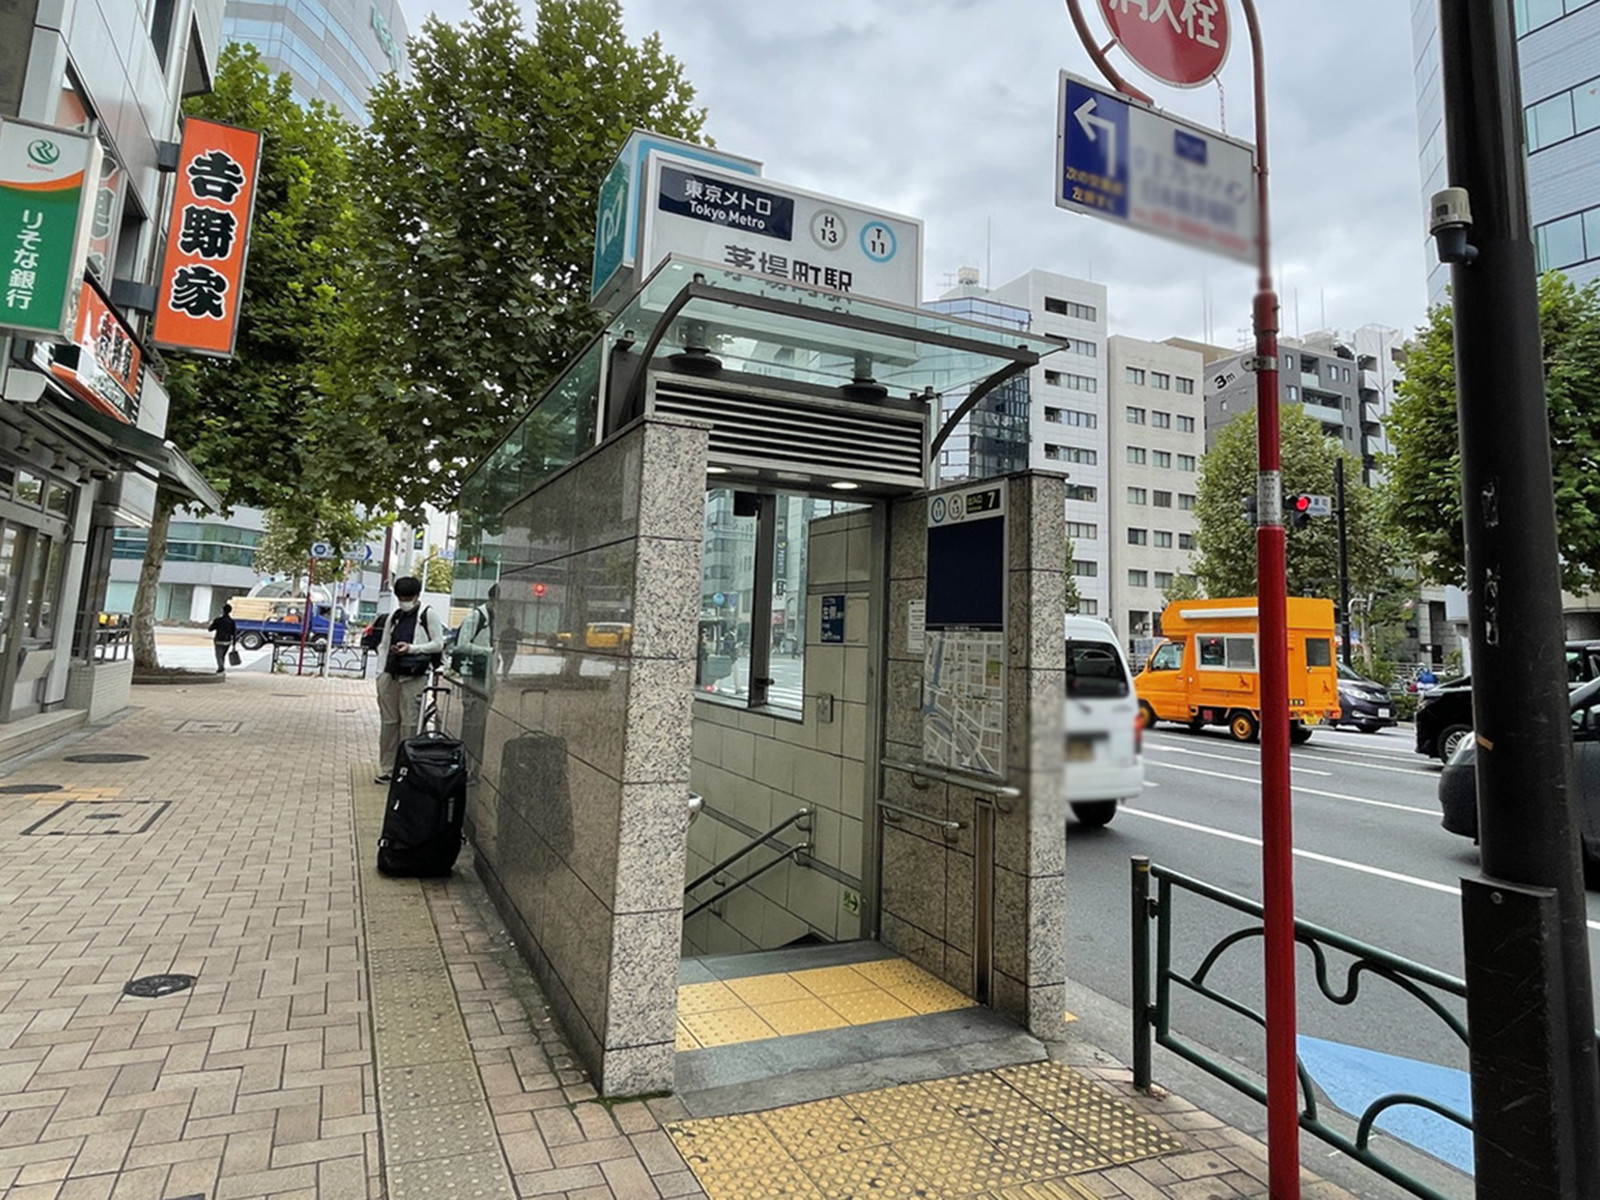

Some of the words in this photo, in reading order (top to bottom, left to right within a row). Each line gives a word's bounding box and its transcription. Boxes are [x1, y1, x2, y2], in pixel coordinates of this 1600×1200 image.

[685, 179, 771, 216] 東京メトロ
[690, 201, 727, 221] Tokyo
[728, 209, 765, 230] Metro
[824, 215, 834, 228] H
[168, 148, 246, 320] 吉野家
[820, 228, 838, 244] 13
[875, 228, 883, 240] T
[870, 240, 886, 255] 11
[6, 208, 43, 310] りそな銀行
[1214, 372, 1236, 389] 3m
[988, 491, 996, 508] 7
